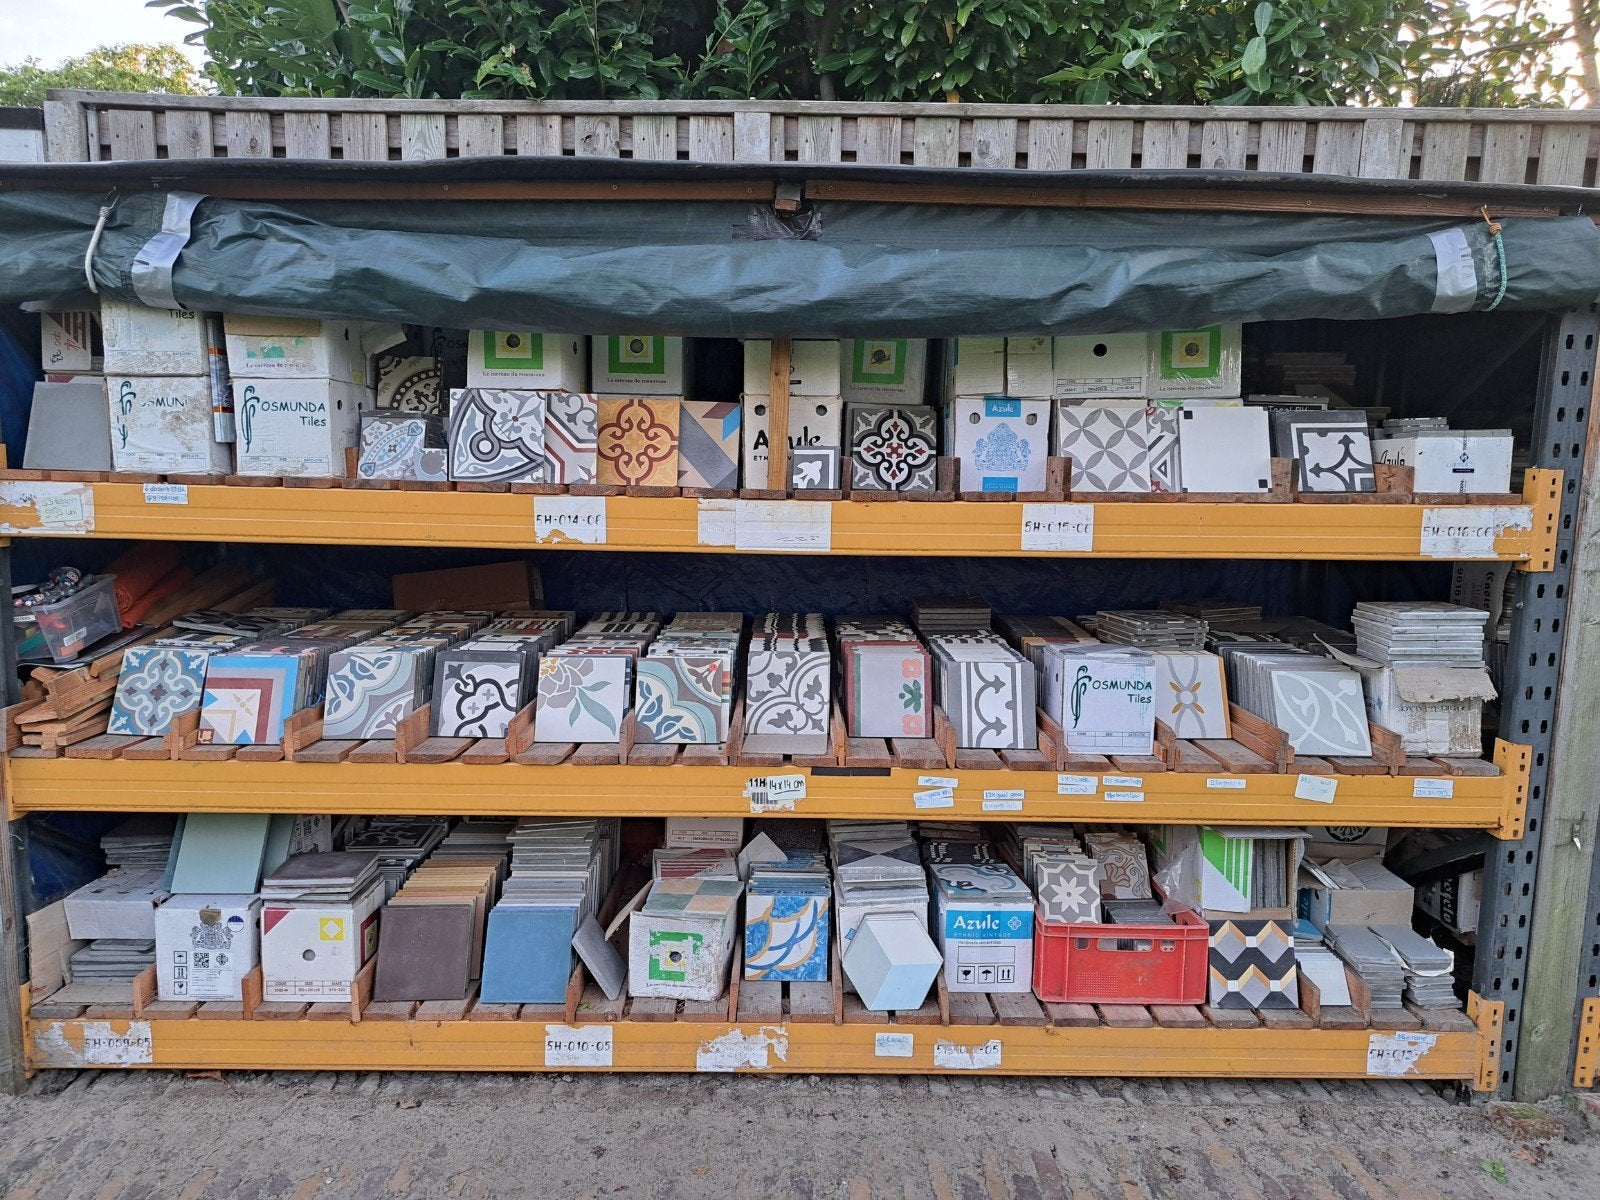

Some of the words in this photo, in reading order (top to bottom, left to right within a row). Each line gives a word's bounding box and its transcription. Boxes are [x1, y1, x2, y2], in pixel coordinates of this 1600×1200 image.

[168, 309, 195, 320] Tiles
[261, 401, 326, 413] OSMUNDA
[991, 405, 1014, 414] Azule
[299, 416, 327, 427] Tiles
[753, 425, 821, 450] Aule
[1092, 680, 1153, 691] OSMUNDA
[1127, 693, 1152, 704] Tiles
[953, 914, 1000, 930] Azule
